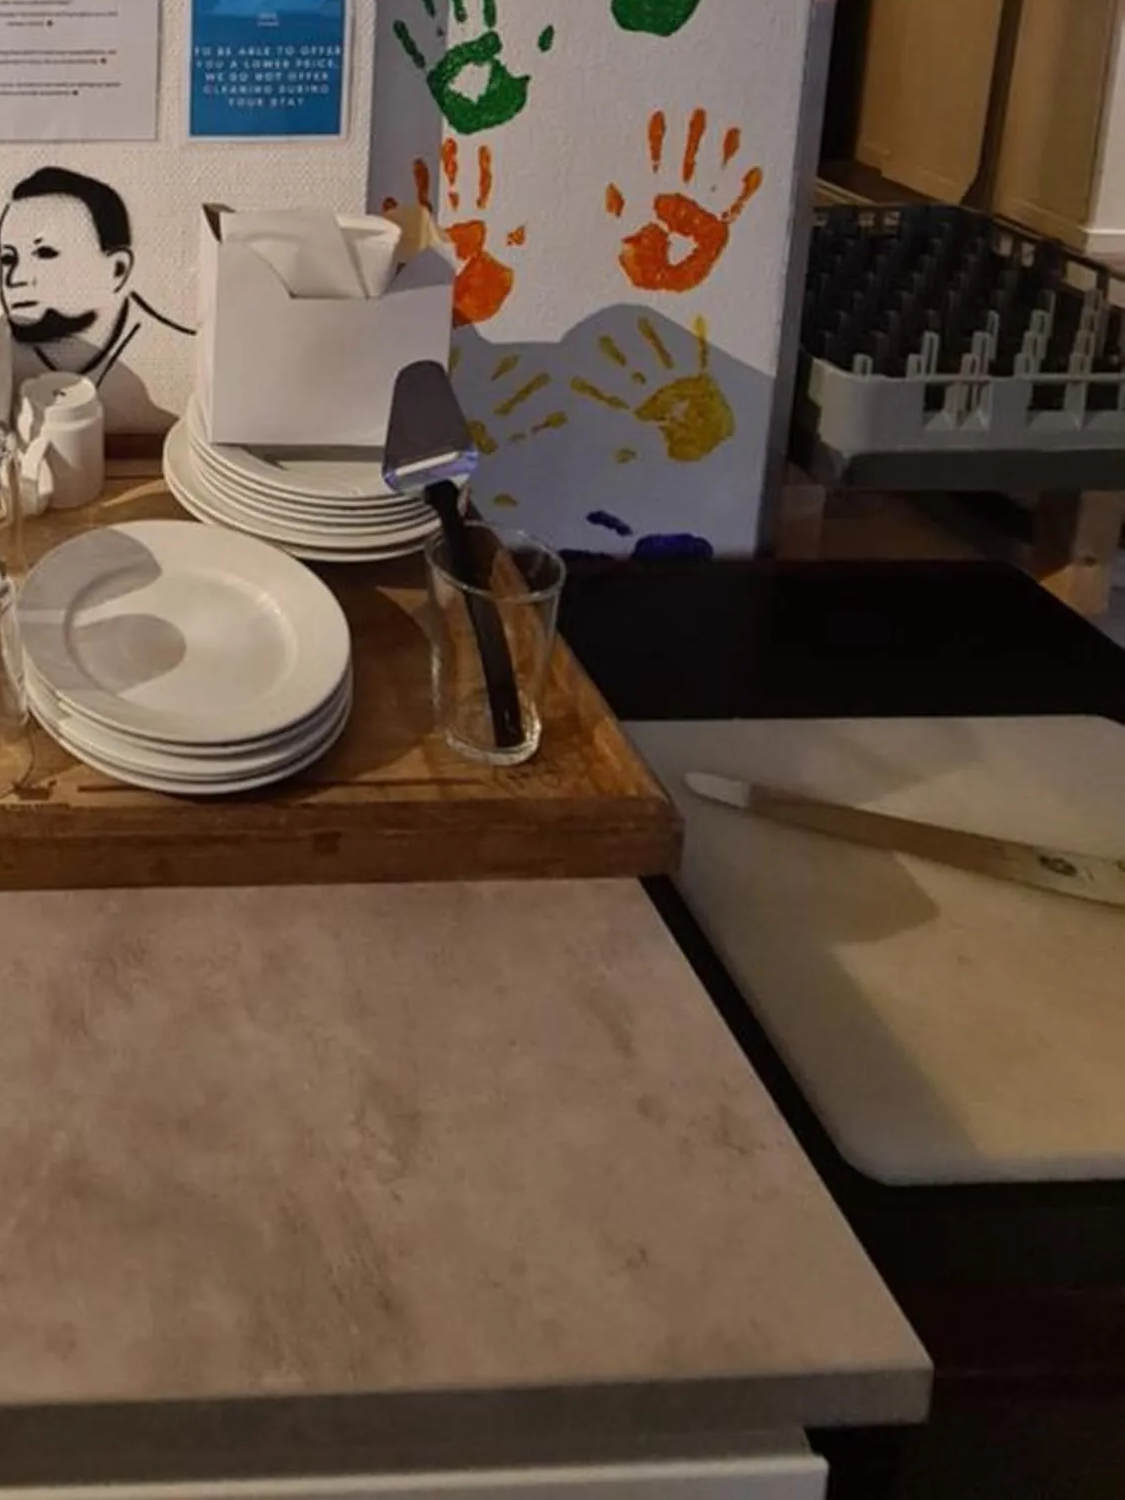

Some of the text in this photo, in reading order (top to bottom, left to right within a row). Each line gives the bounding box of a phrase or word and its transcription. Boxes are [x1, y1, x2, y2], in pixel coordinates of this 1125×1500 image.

[217, 46, 231, 56] BE
[238, 46, 270, 56] ABLE
[277, 45, 295, 56] TO
[300, 45, 340, 56] OFFER
[196, 59, 224, 69] YOU
[244, 59, 290, 69] LOWER
[204, 71, 329, 82] WE DO NOT OFFER
[227, 97, 304, 107] YOUR STAY
